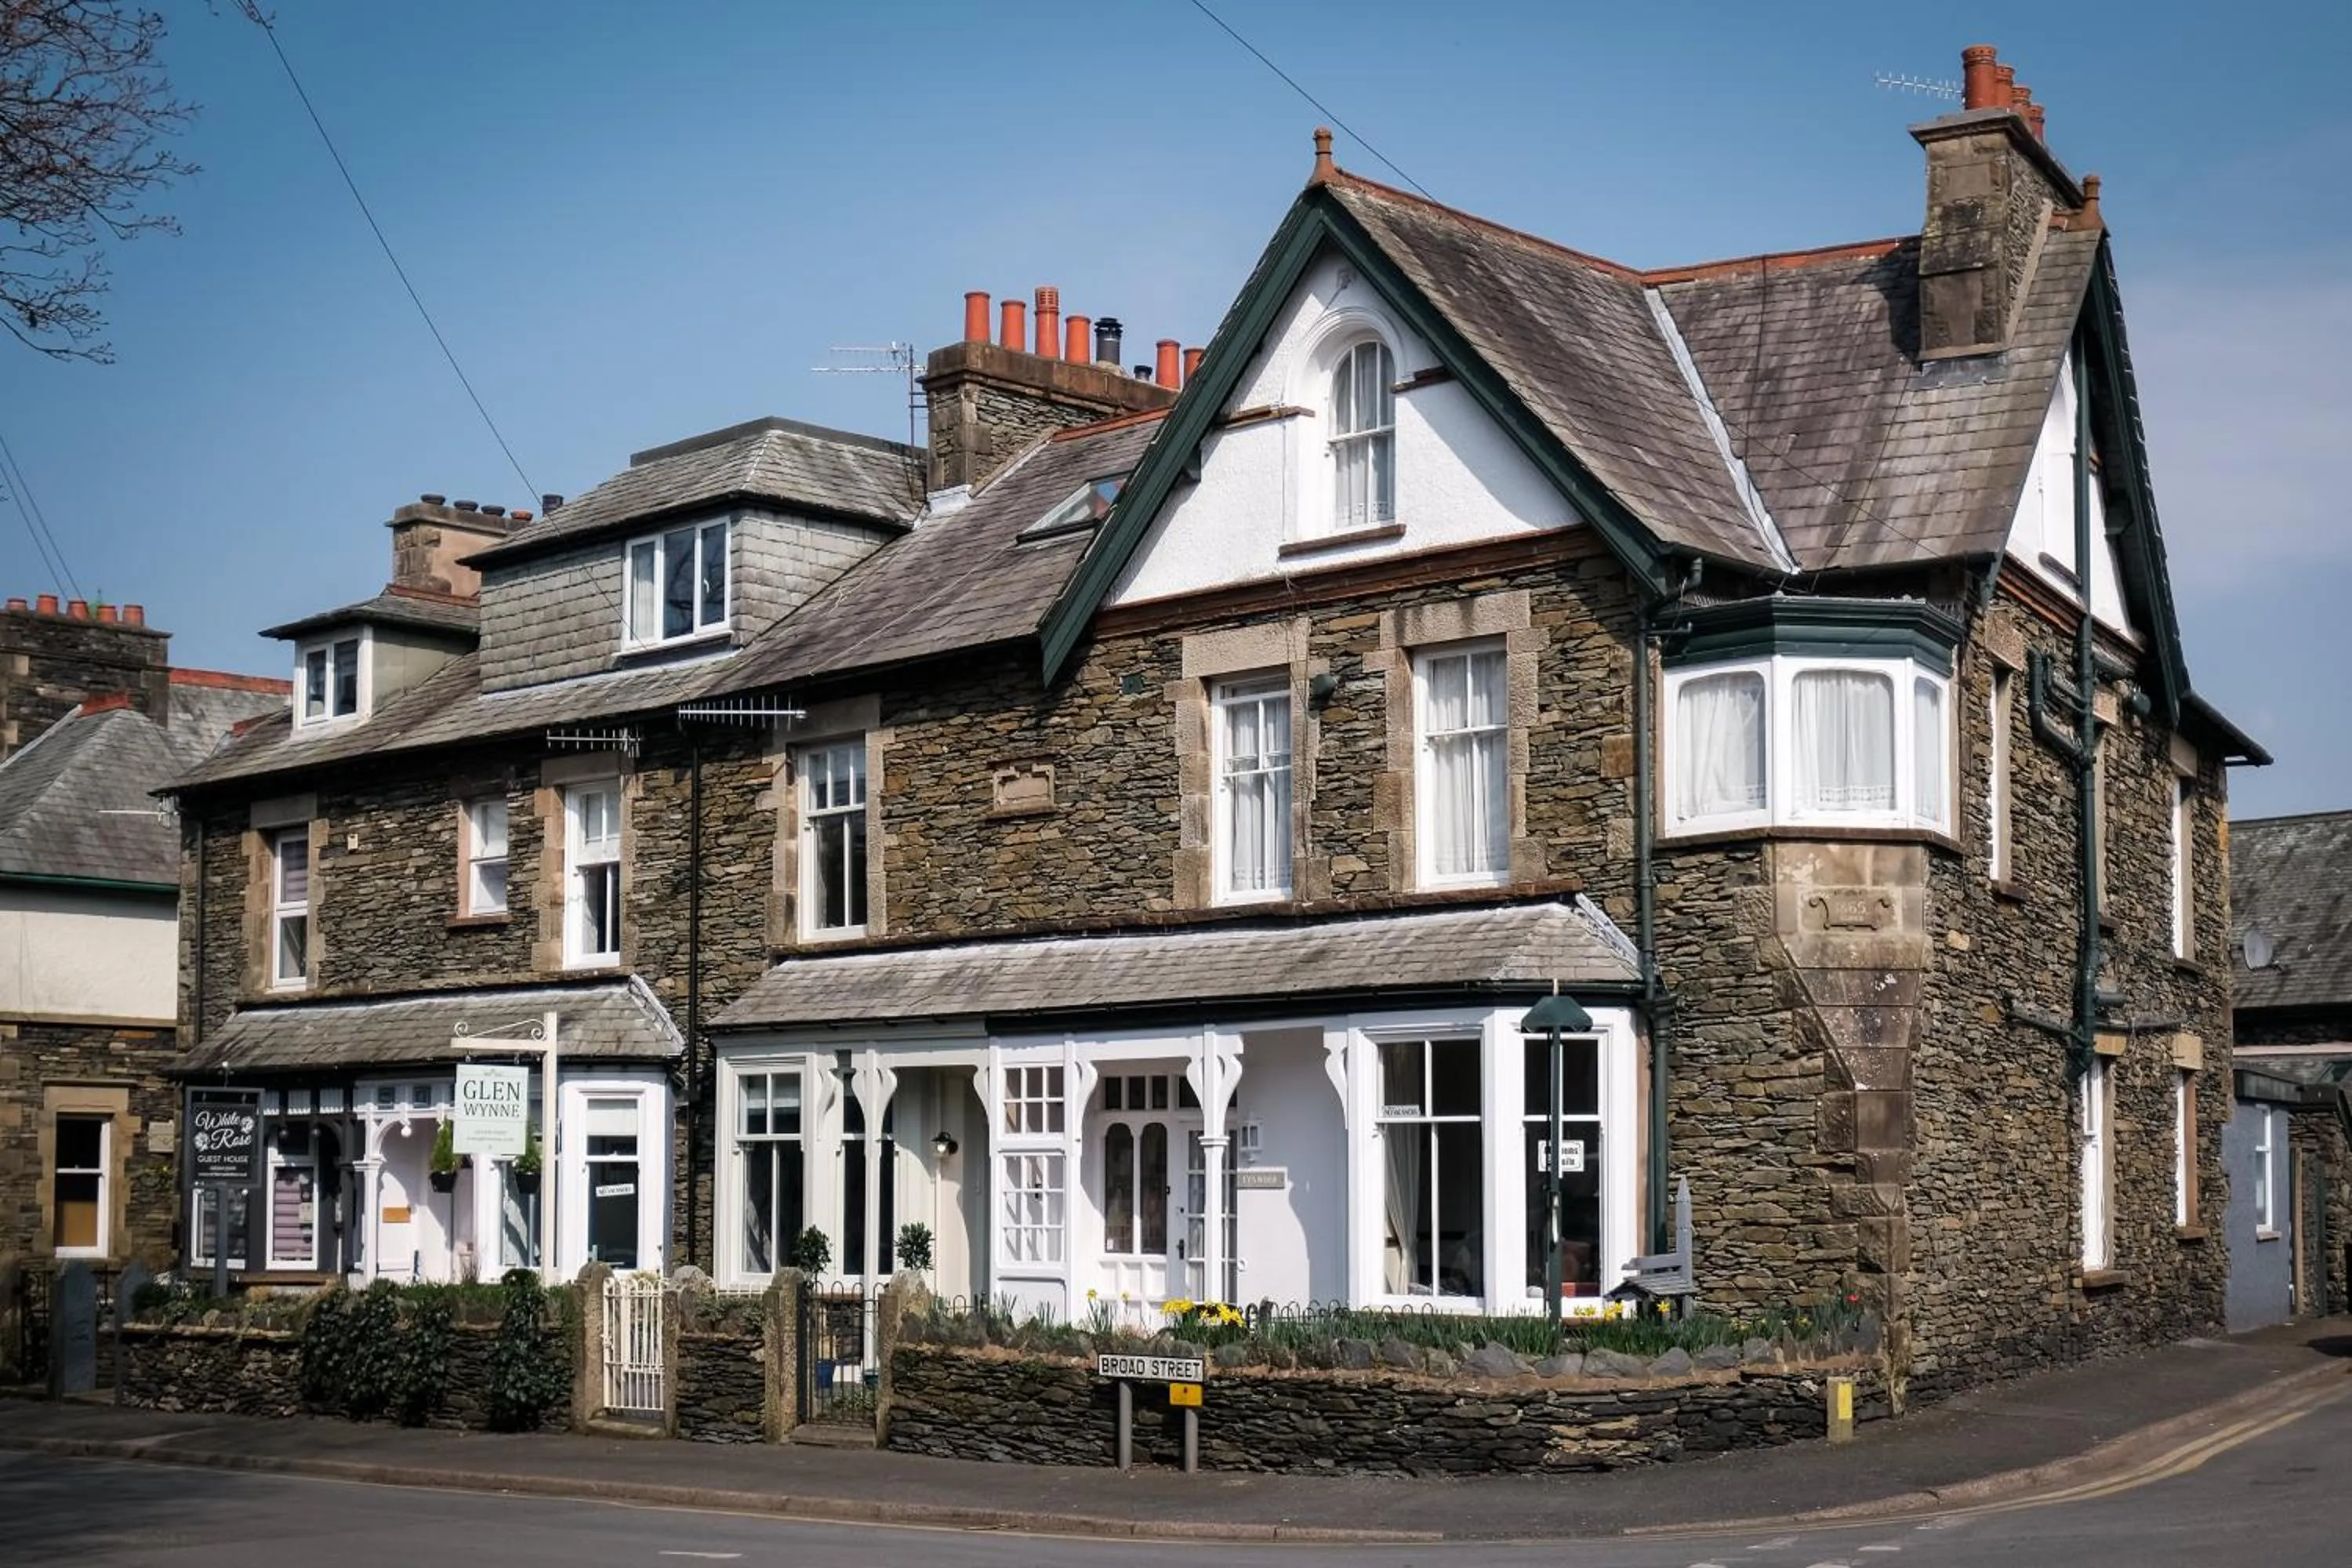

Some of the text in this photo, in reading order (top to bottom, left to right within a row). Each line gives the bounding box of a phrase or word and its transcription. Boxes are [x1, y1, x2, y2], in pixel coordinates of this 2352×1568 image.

[463, 1080, 521, 1101] GLEN
[463, 1103, 520, 1117] WYNNE
[194, 1111, 241, 1131] White
[210, 1128, 252, 1150] Rose
[223, 1155, 249, 1163] HOUSE
[1102, 1357, 1200, 1379] BROAD STREET
